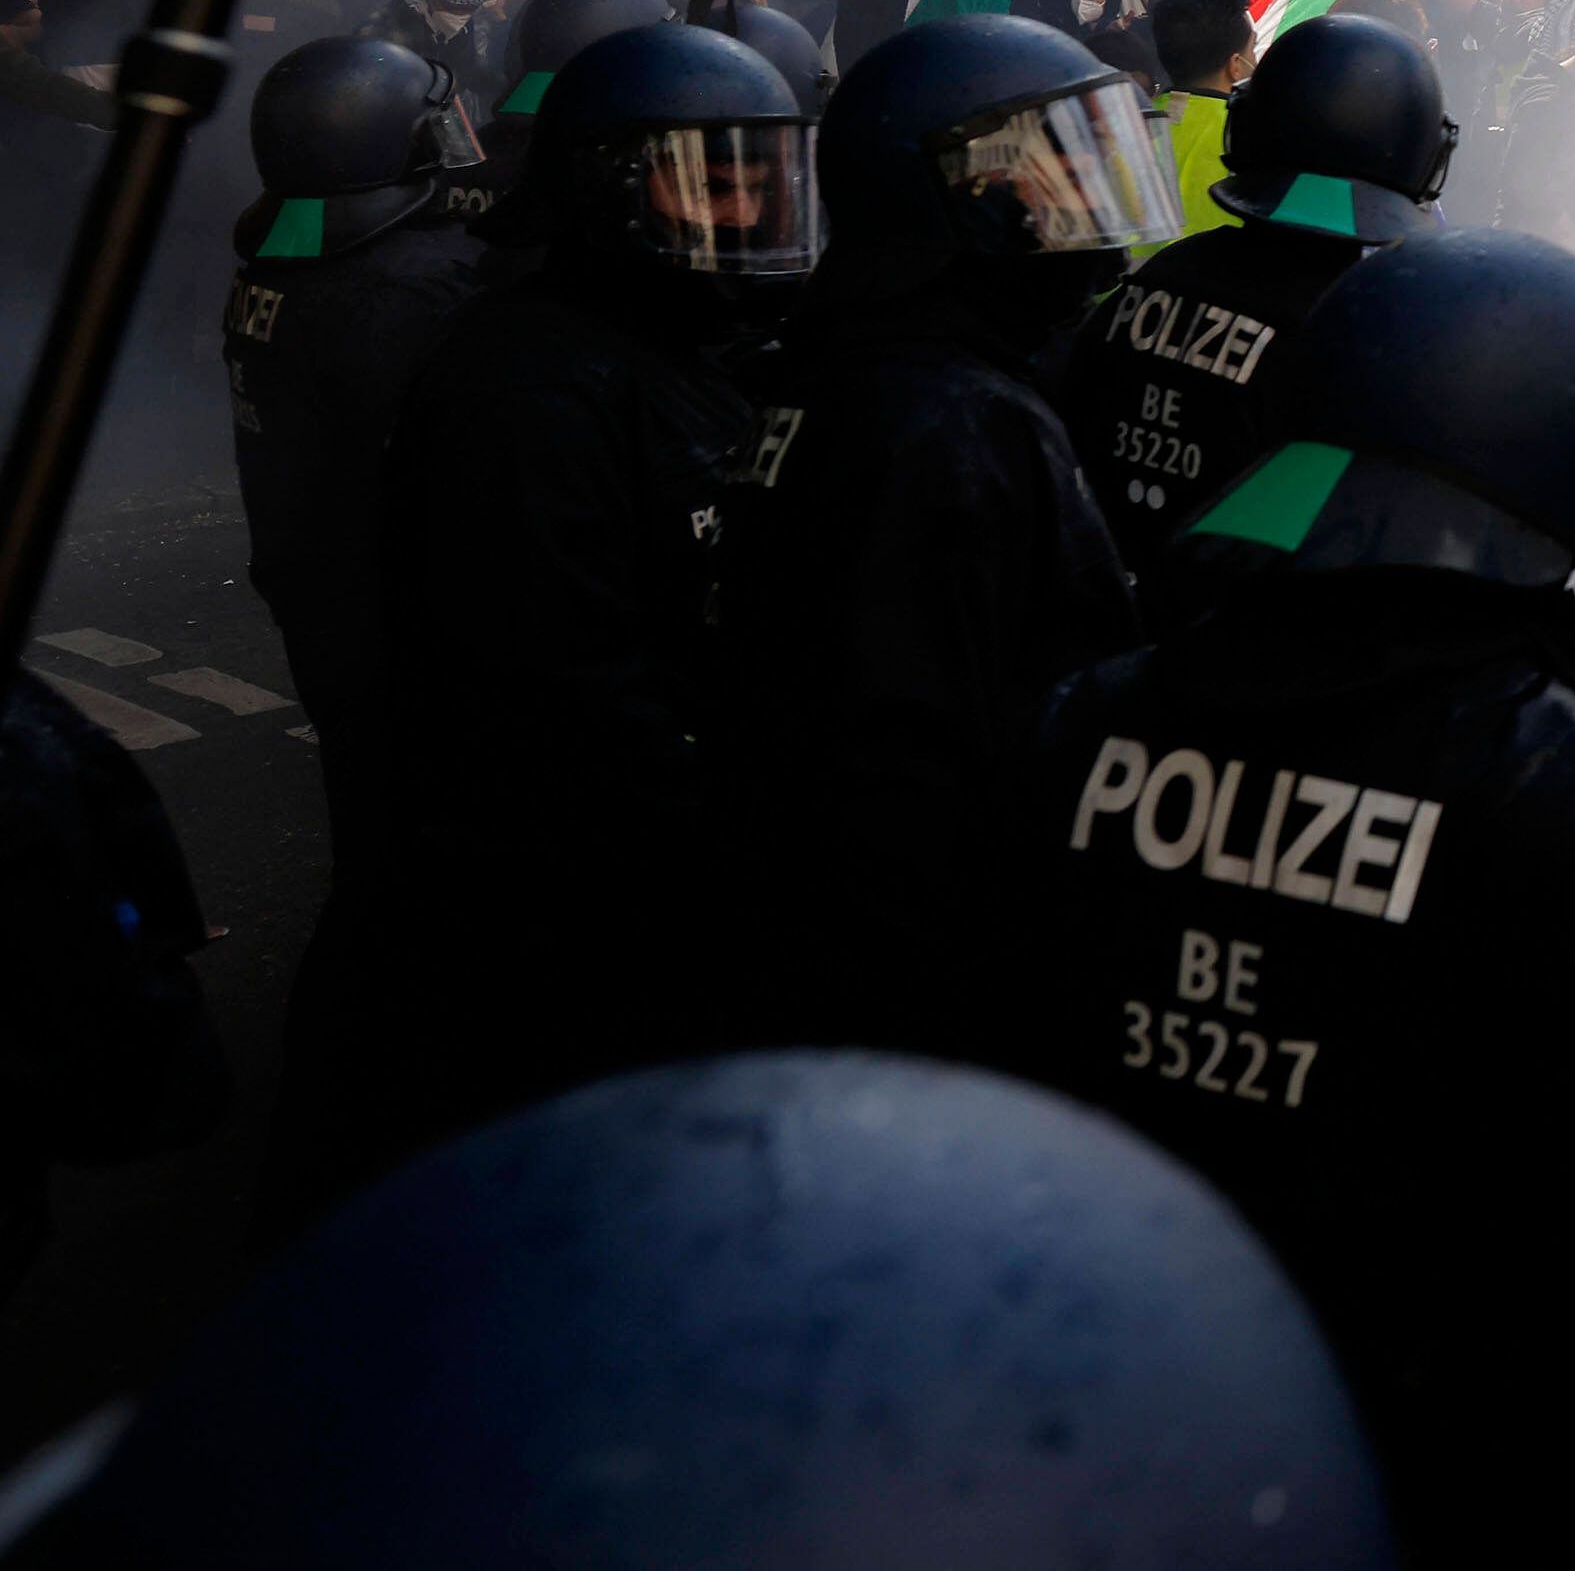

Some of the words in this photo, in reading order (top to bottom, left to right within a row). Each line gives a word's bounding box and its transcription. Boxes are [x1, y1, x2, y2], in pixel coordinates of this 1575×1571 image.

[1106, 284, 1275, 385] POLIZEI
[1114, 423, 1202, 480] 35220
[1141, 382, 1181, 429] BE
[1069, 735, 1444, 925] POLIZEI
[1176, 928, 1264, 1016] BE
[1122, 1000, 1319, 1108] 35227
